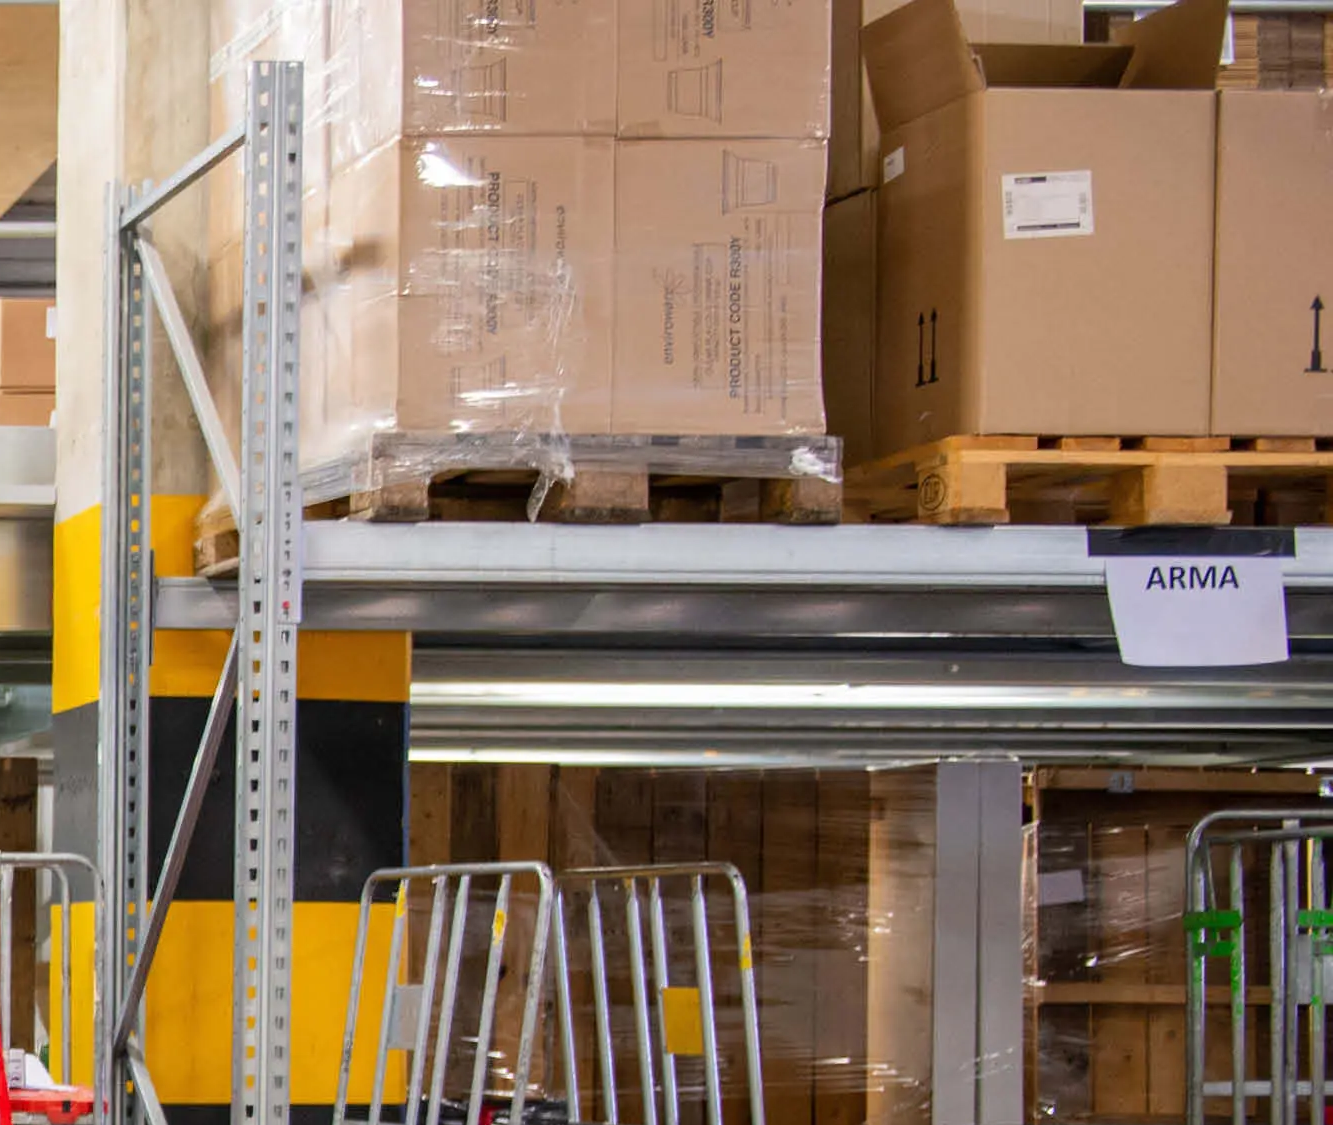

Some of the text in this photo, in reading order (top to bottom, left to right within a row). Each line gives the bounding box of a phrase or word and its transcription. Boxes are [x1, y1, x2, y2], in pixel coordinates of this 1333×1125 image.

[729, 282, 741, 324] CODE
[729, 329, 741, 399] PRODUCT
[1146, 565, 1239, 589] ARMA
